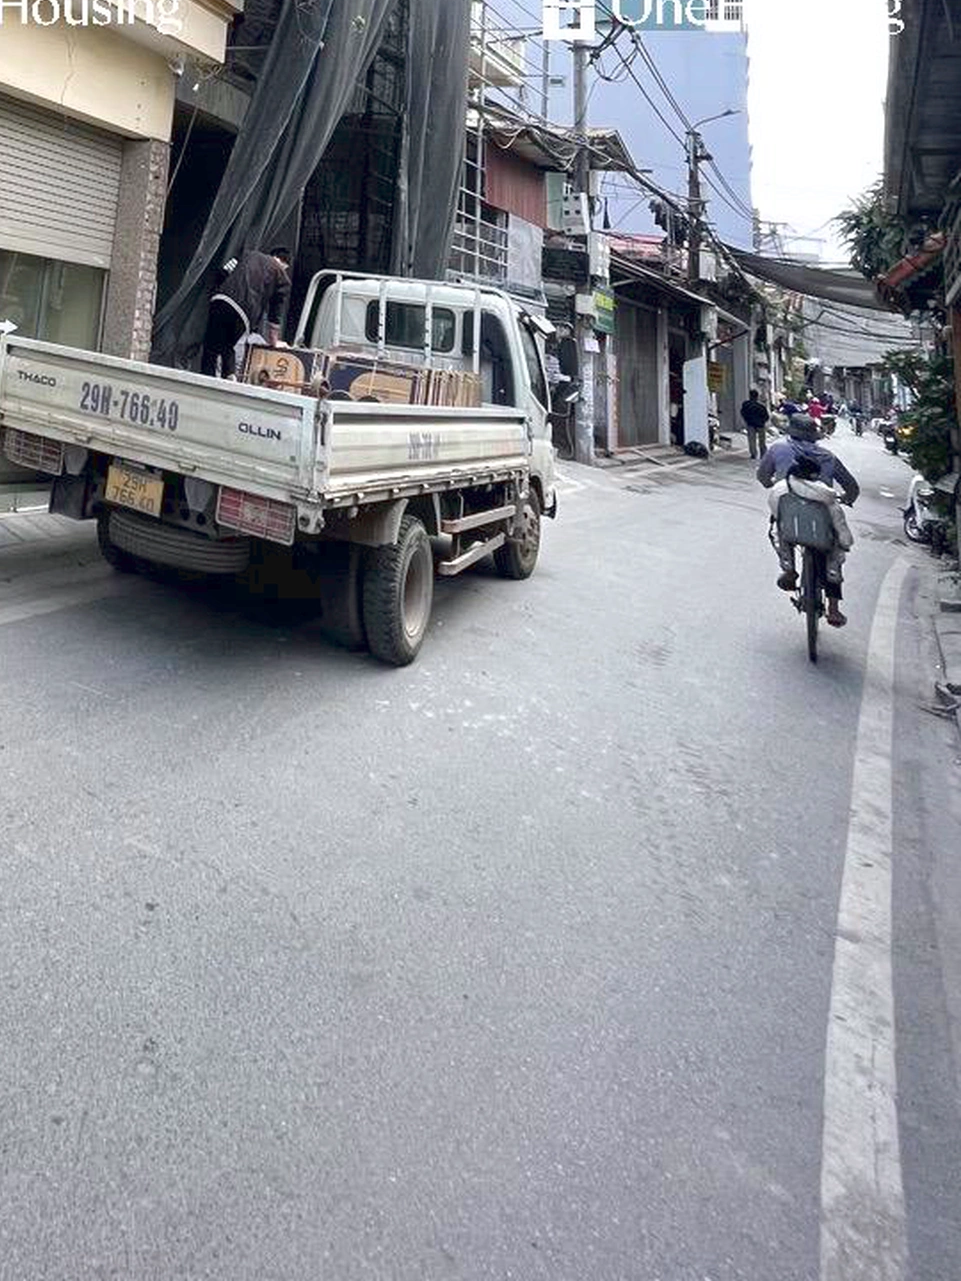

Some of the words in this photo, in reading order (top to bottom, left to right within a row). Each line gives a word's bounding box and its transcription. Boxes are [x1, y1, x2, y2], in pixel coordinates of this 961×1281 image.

[17, 370, 57, 388] THACO
[79, 381, 179, 433] 29H-766.40
[237, 422, 282, 441] OLLIN
